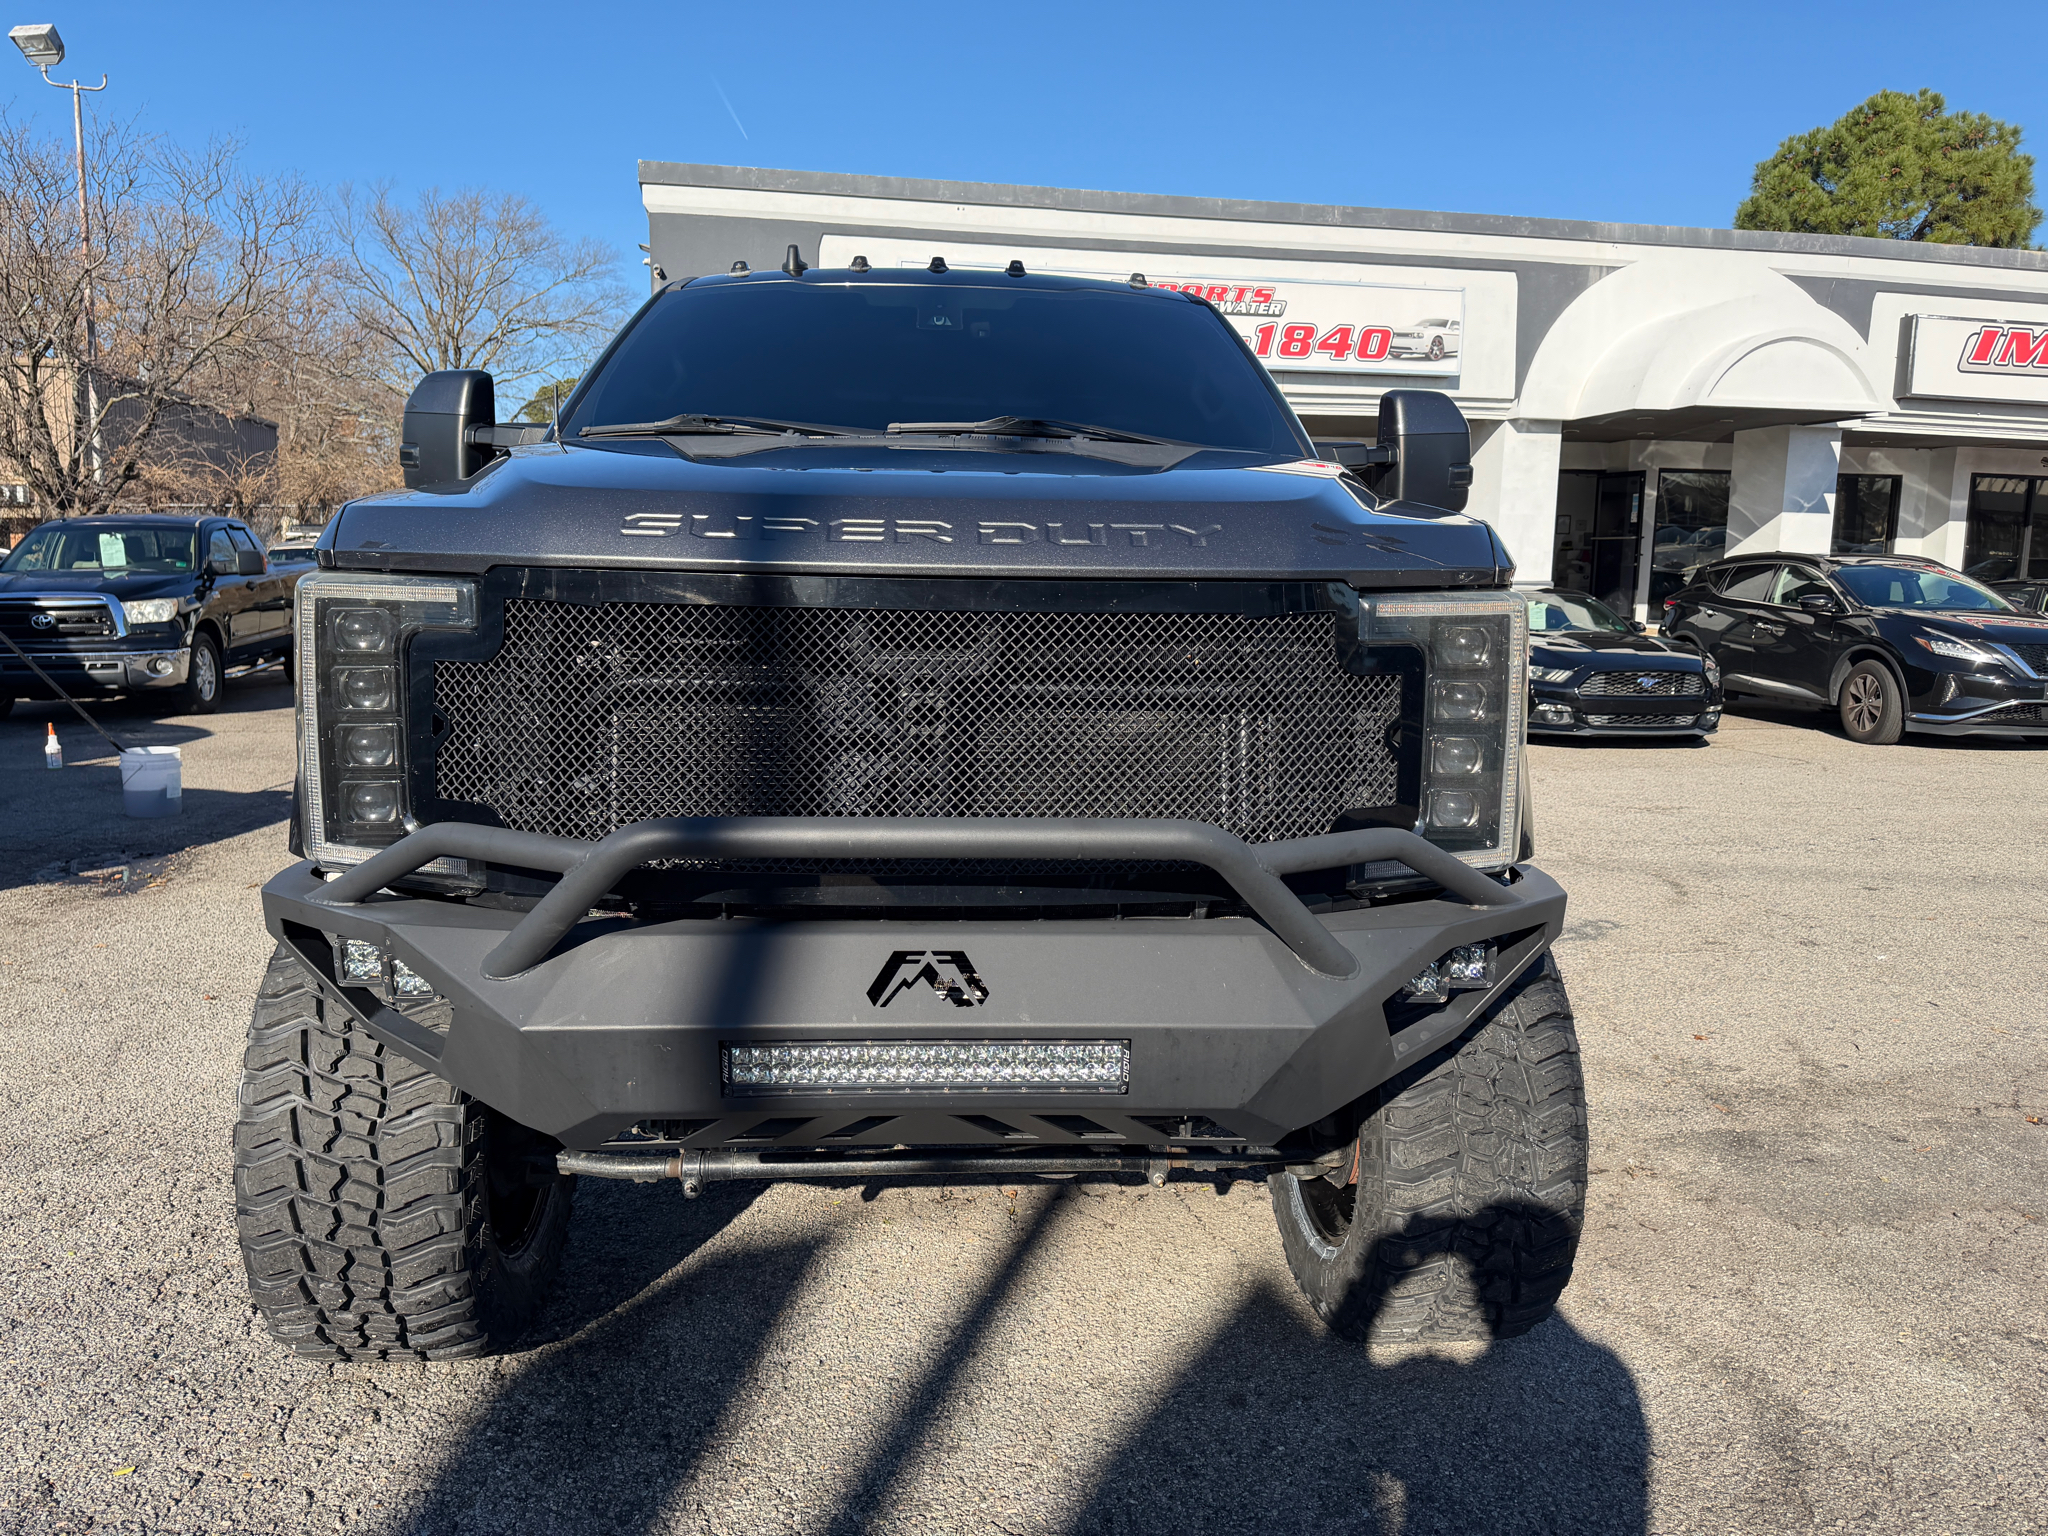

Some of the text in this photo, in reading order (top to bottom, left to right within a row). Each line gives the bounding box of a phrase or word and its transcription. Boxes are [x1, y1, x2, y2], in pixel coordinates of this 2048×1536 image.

[1247, 322, 1395, 362] 1840
[620, 512, 1224, 548] SUPER DUTY
[721, 1049, 729, 1083] RIGID
[1122, 1048, 1130, 1082] RIGID
